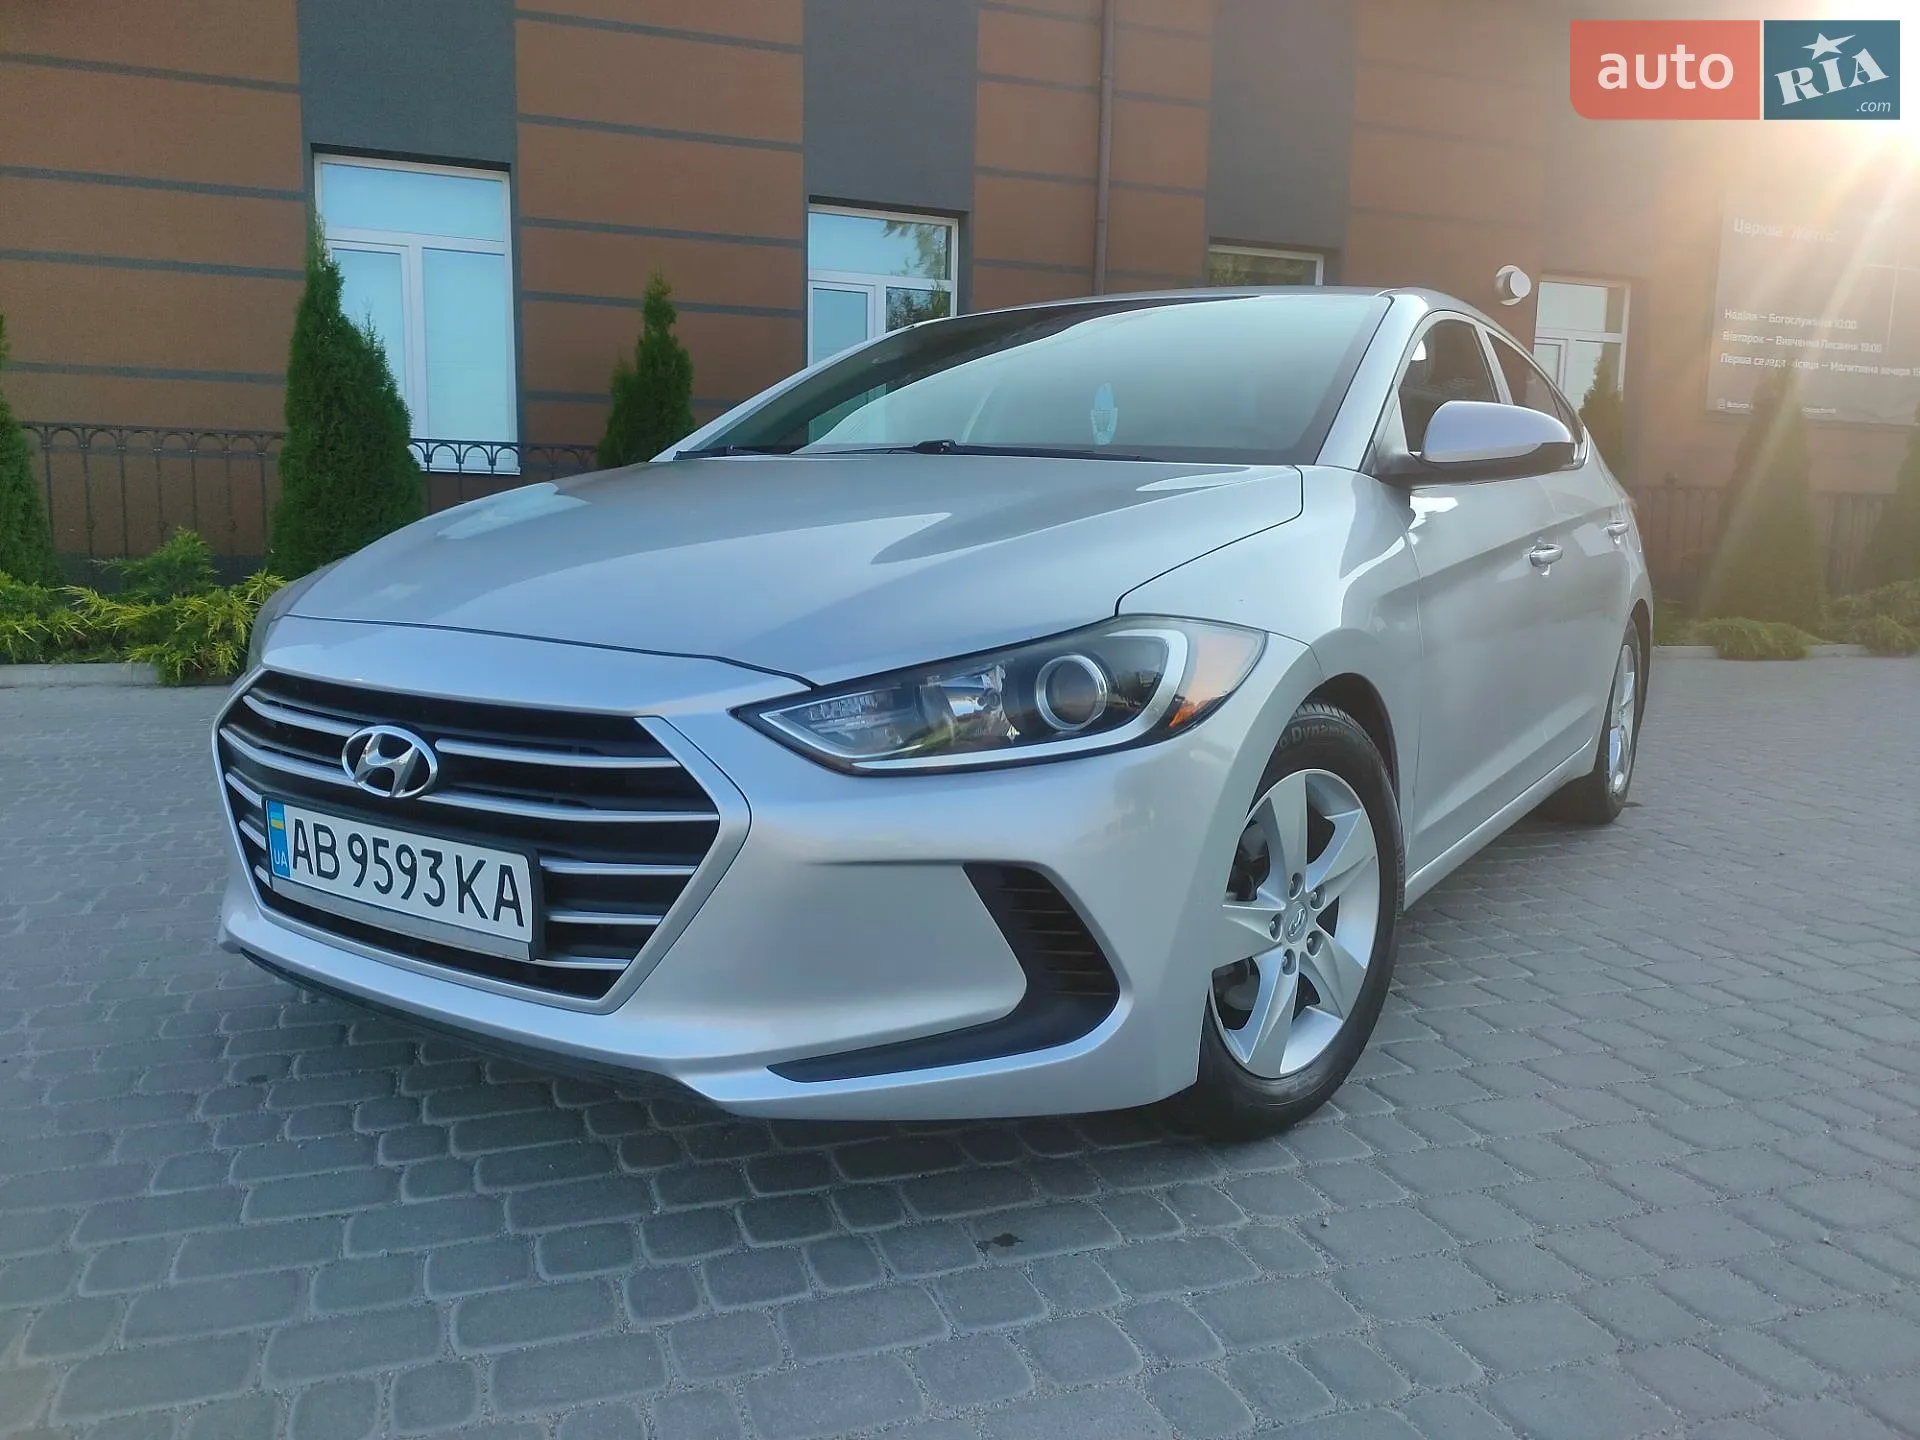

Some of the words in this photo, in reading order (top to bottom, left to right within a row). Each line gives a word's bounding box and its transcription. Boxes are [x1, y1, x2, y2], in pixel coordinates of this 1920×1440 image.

[273, 848, 287, 868] UA
[292, 818, 340, 880] AB
[347, 832, 446, 908] 9593
[455, 854, 524, 928] KA
